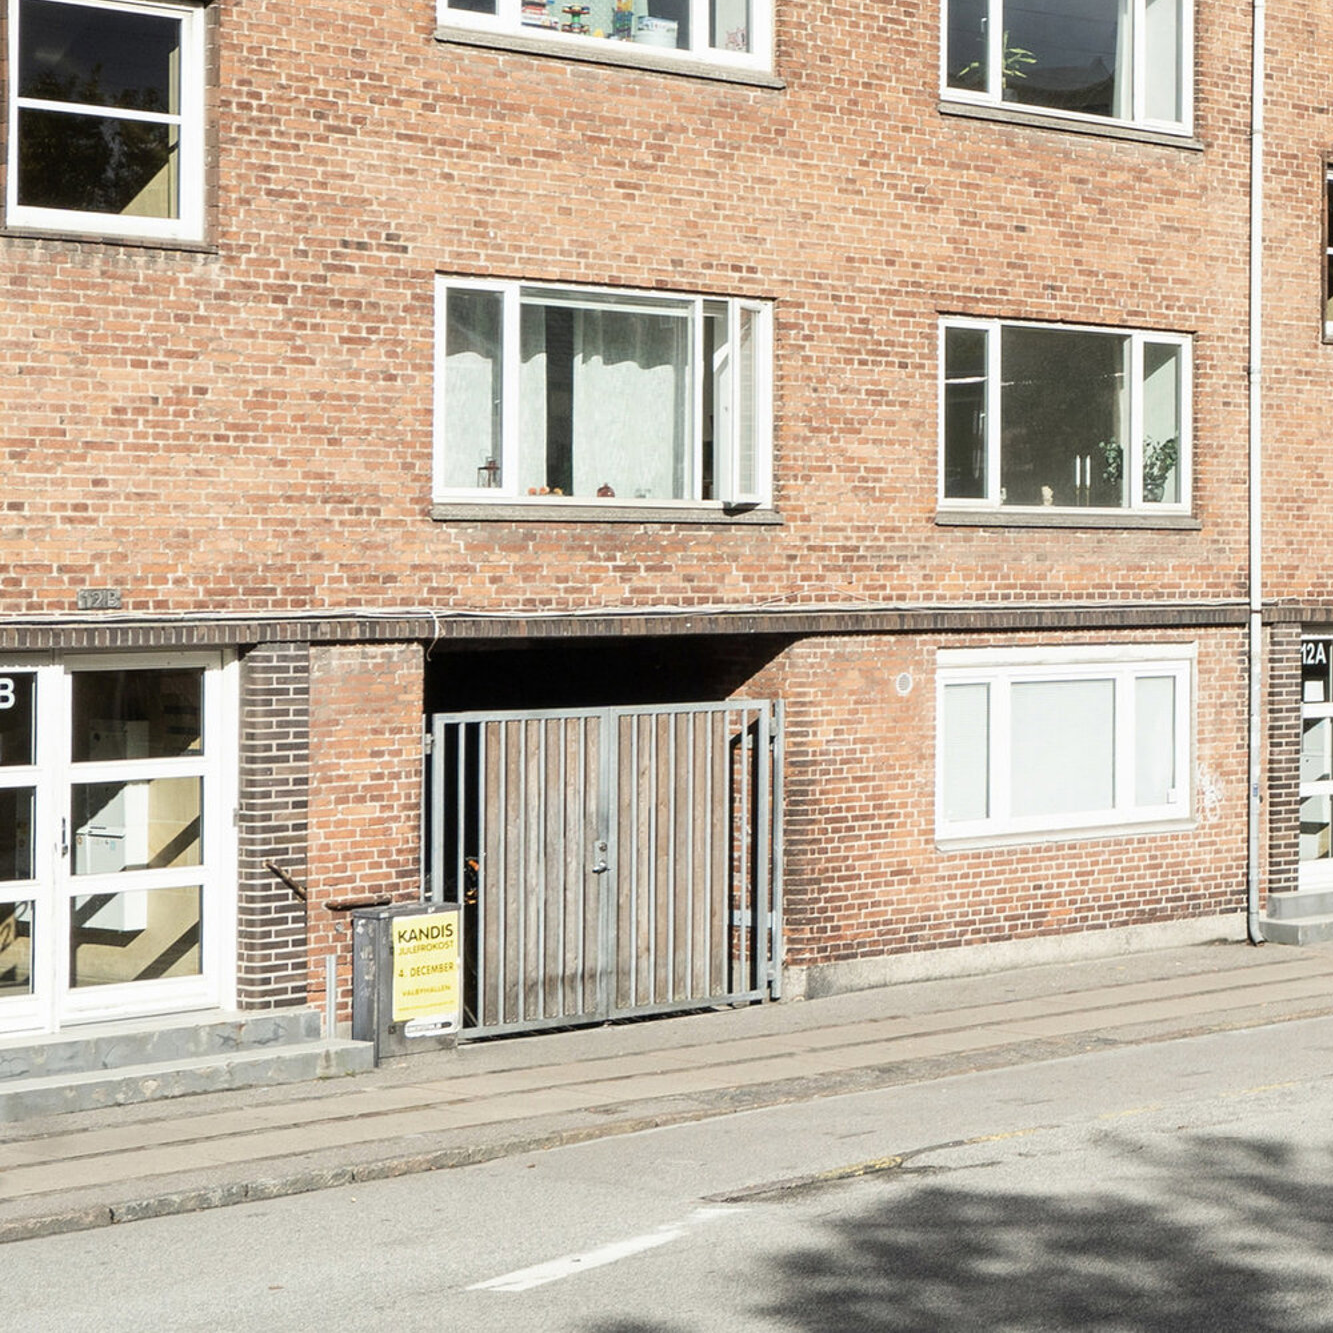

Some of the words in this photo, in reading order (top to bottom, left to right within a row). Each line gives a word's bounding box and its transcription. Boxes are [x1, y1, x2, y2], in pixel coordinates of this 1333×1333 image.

[81, 589, 119, 608] 12B
[1300, 642, 1327, 665] 12A
[397, 923, 455, 944] KANDIS
[398, 940, 455, 956] JULEFROKOST
[409, 961, 455, 978] DECEMBER
